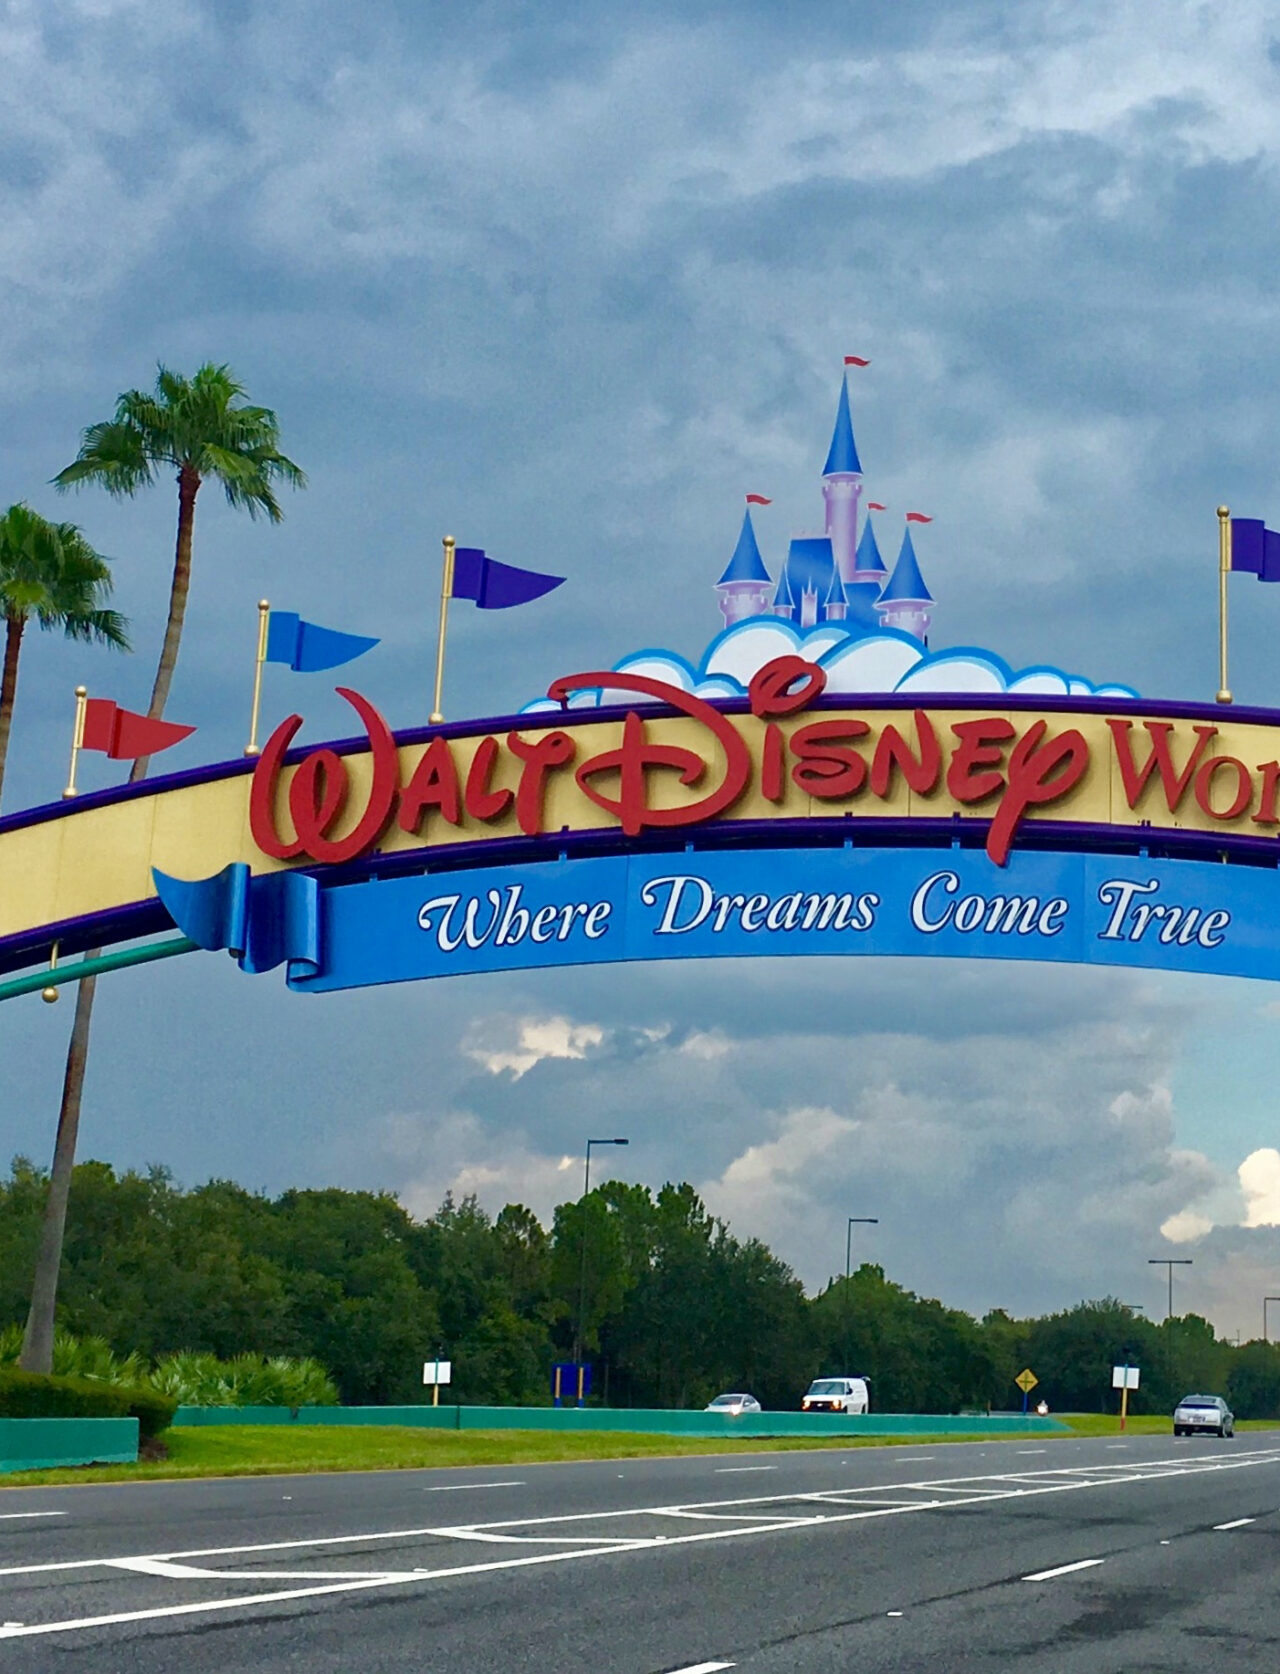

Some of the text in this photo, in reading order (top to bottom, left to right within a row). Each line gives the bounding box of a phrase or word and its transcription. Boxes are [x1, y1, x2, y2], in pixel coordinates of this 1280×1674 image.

[418, 872, 1232, 952] Where Dreams Come True
